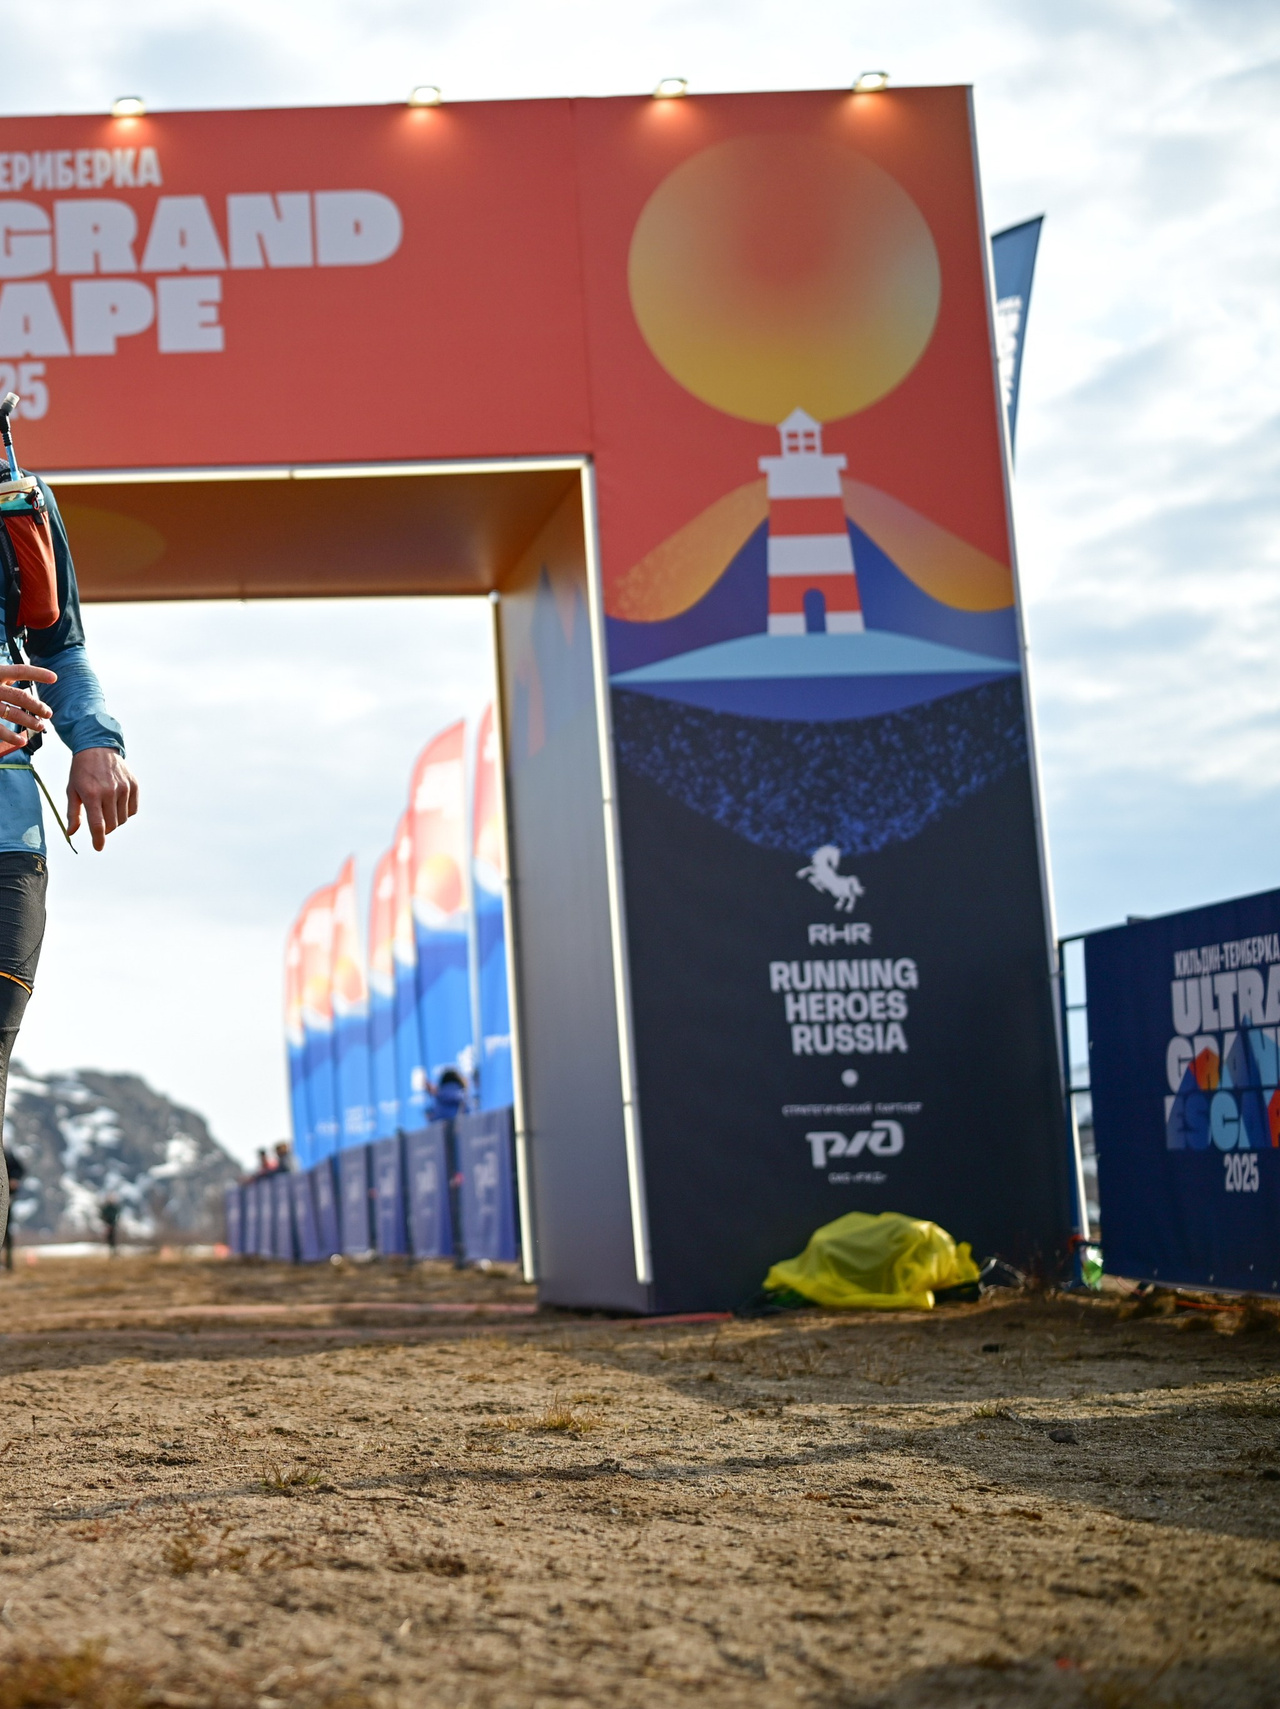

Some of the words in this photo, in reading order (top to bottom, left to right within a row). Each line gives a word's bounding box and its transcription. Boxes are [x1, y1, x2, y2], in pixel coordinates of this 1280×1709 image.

[808, 922, 872, 946] RHR
[1174, 932, 1280, 979] КИЛЬДИН-ТЕРИБЕРКА
[769, 957, 919, 992] RUNNING
[785, 990, 908, 1024] HEROES
[791, 1021, 908, 1055] RUSSIA
[1166, 1026, 1280, 1096] GRAN
[1223, 1152, 1260, 1193] 2025
